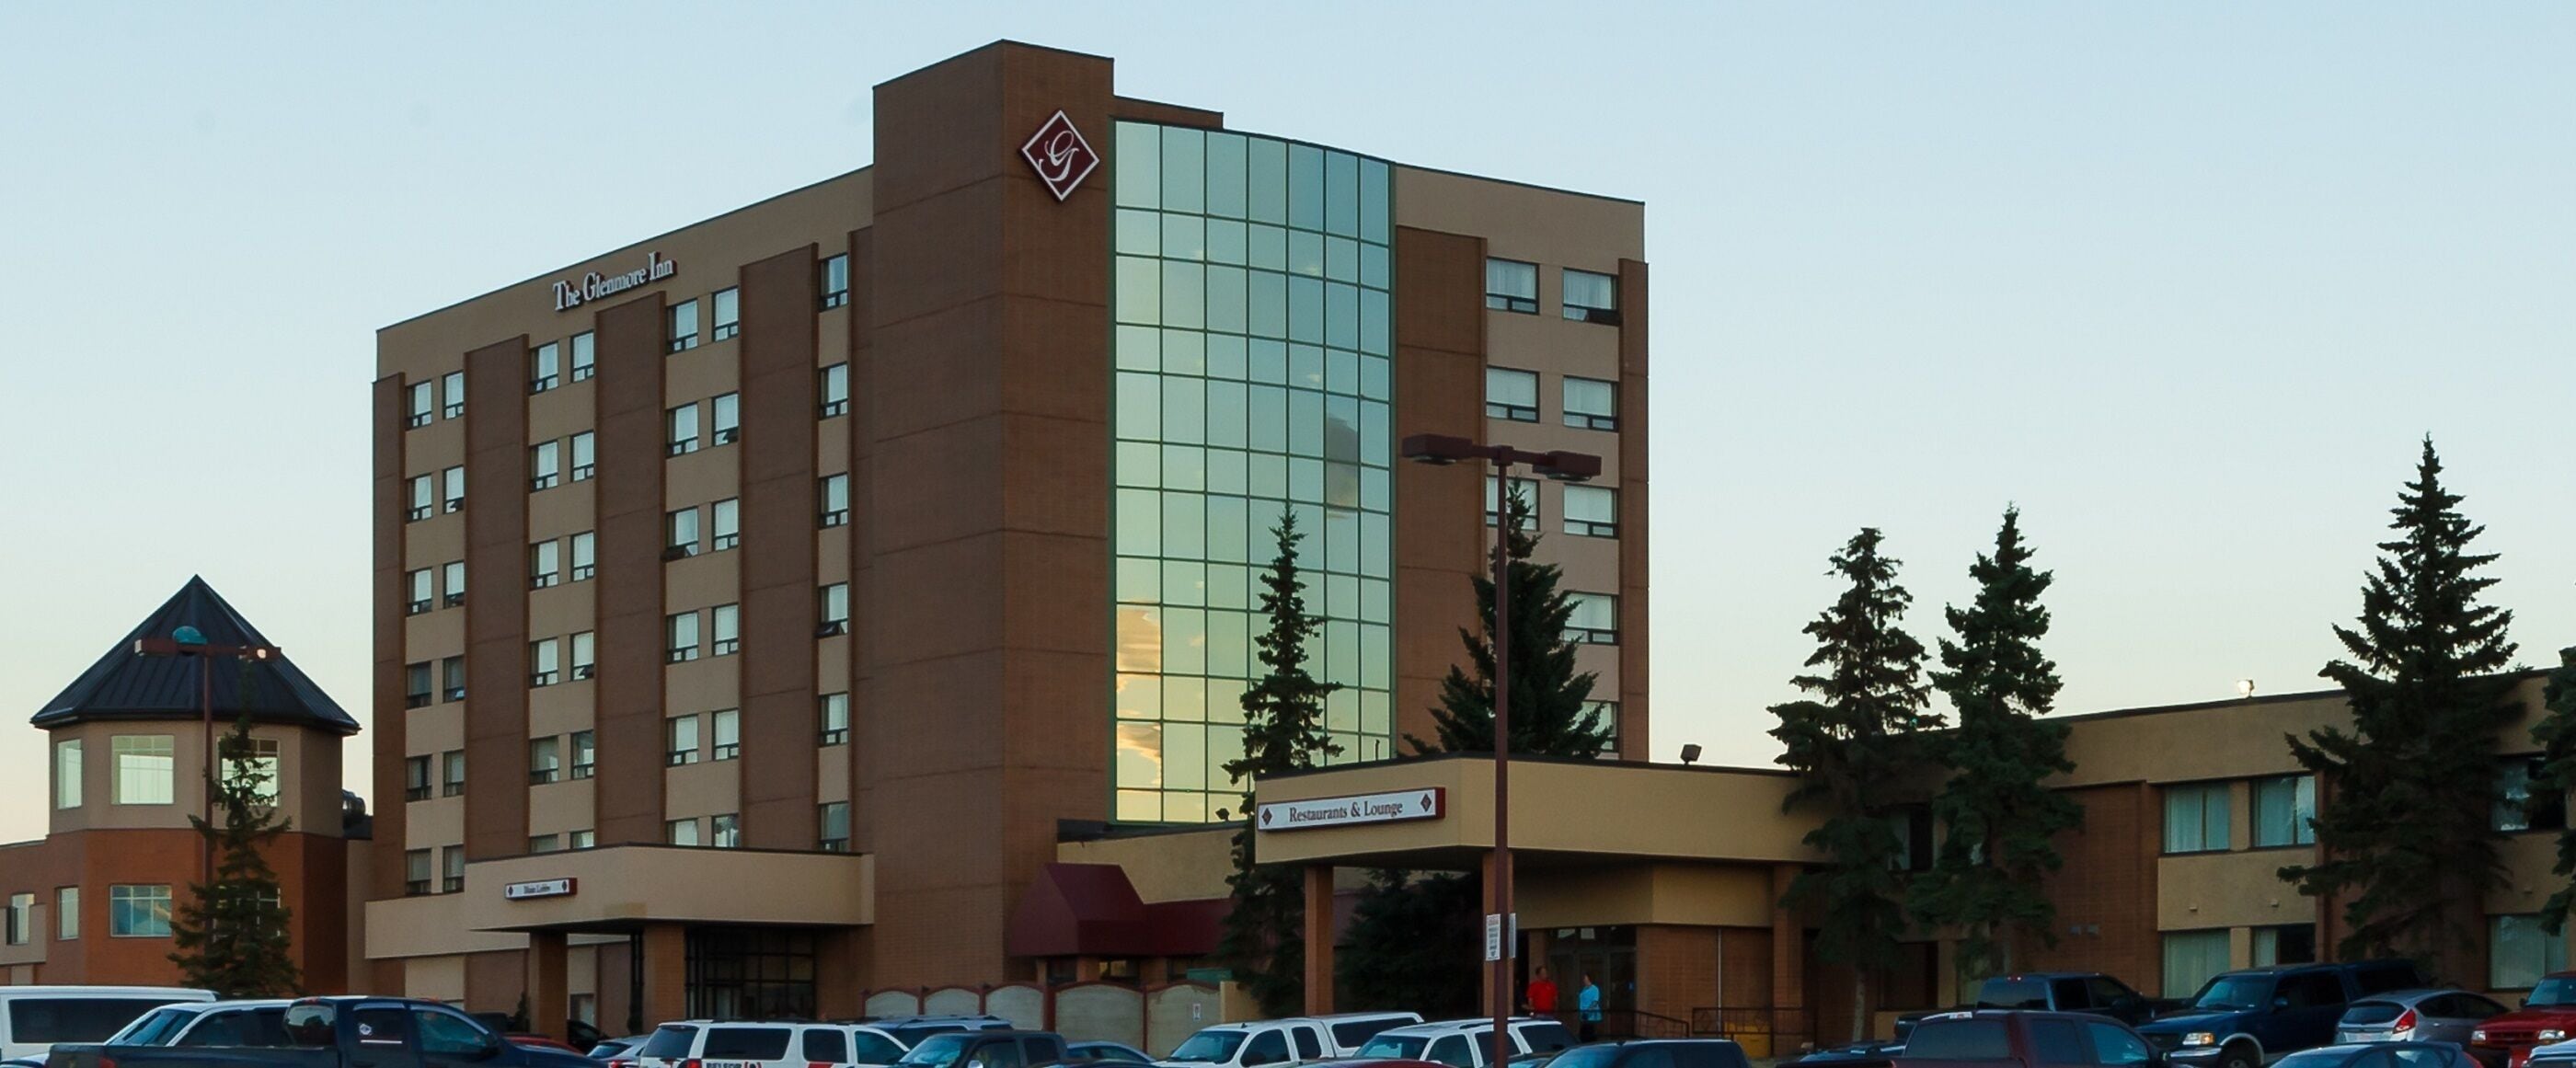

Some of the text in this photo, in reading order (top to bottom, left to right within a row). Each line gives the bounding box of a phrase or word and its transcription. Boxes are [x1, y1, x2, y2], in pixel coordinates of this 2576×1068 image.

[552, 250, 675, 311] The Glenmore Inn
[1289, 799, 1404, 823] Restaurants & Lounge
